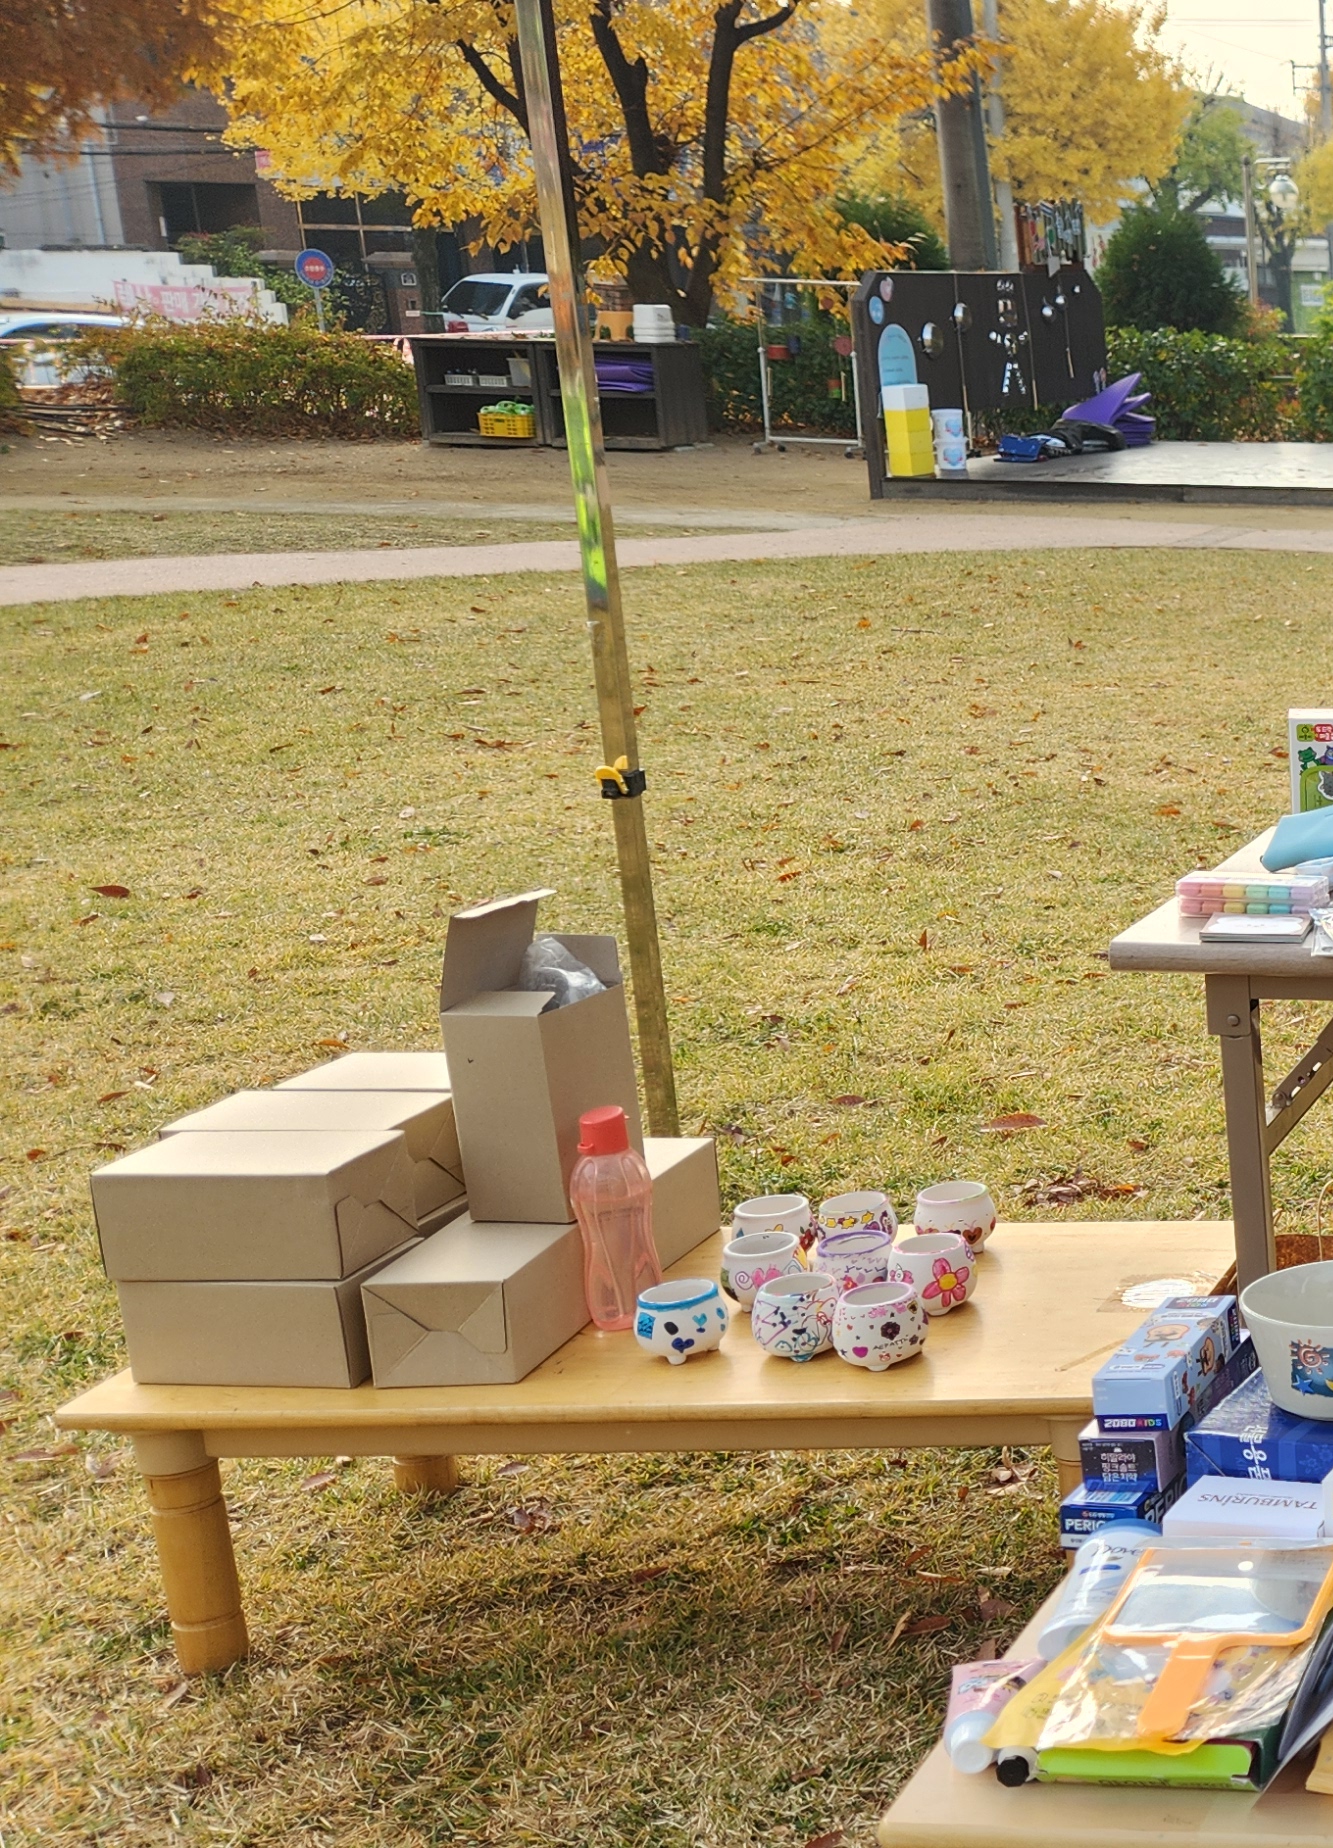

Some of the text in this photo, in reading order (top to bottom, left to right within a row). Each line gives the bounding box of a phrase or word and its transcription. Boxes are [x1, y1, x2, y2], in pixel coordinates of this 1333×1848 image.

[1100, 1453, 1136, 1463] 히말라야
[1101, 1463, 1137, 1473] 핑크솔트
[1198, 1492, 1318, 1510] TAMBURINS
[1064, 1518, 1108, 1532] PERIO
